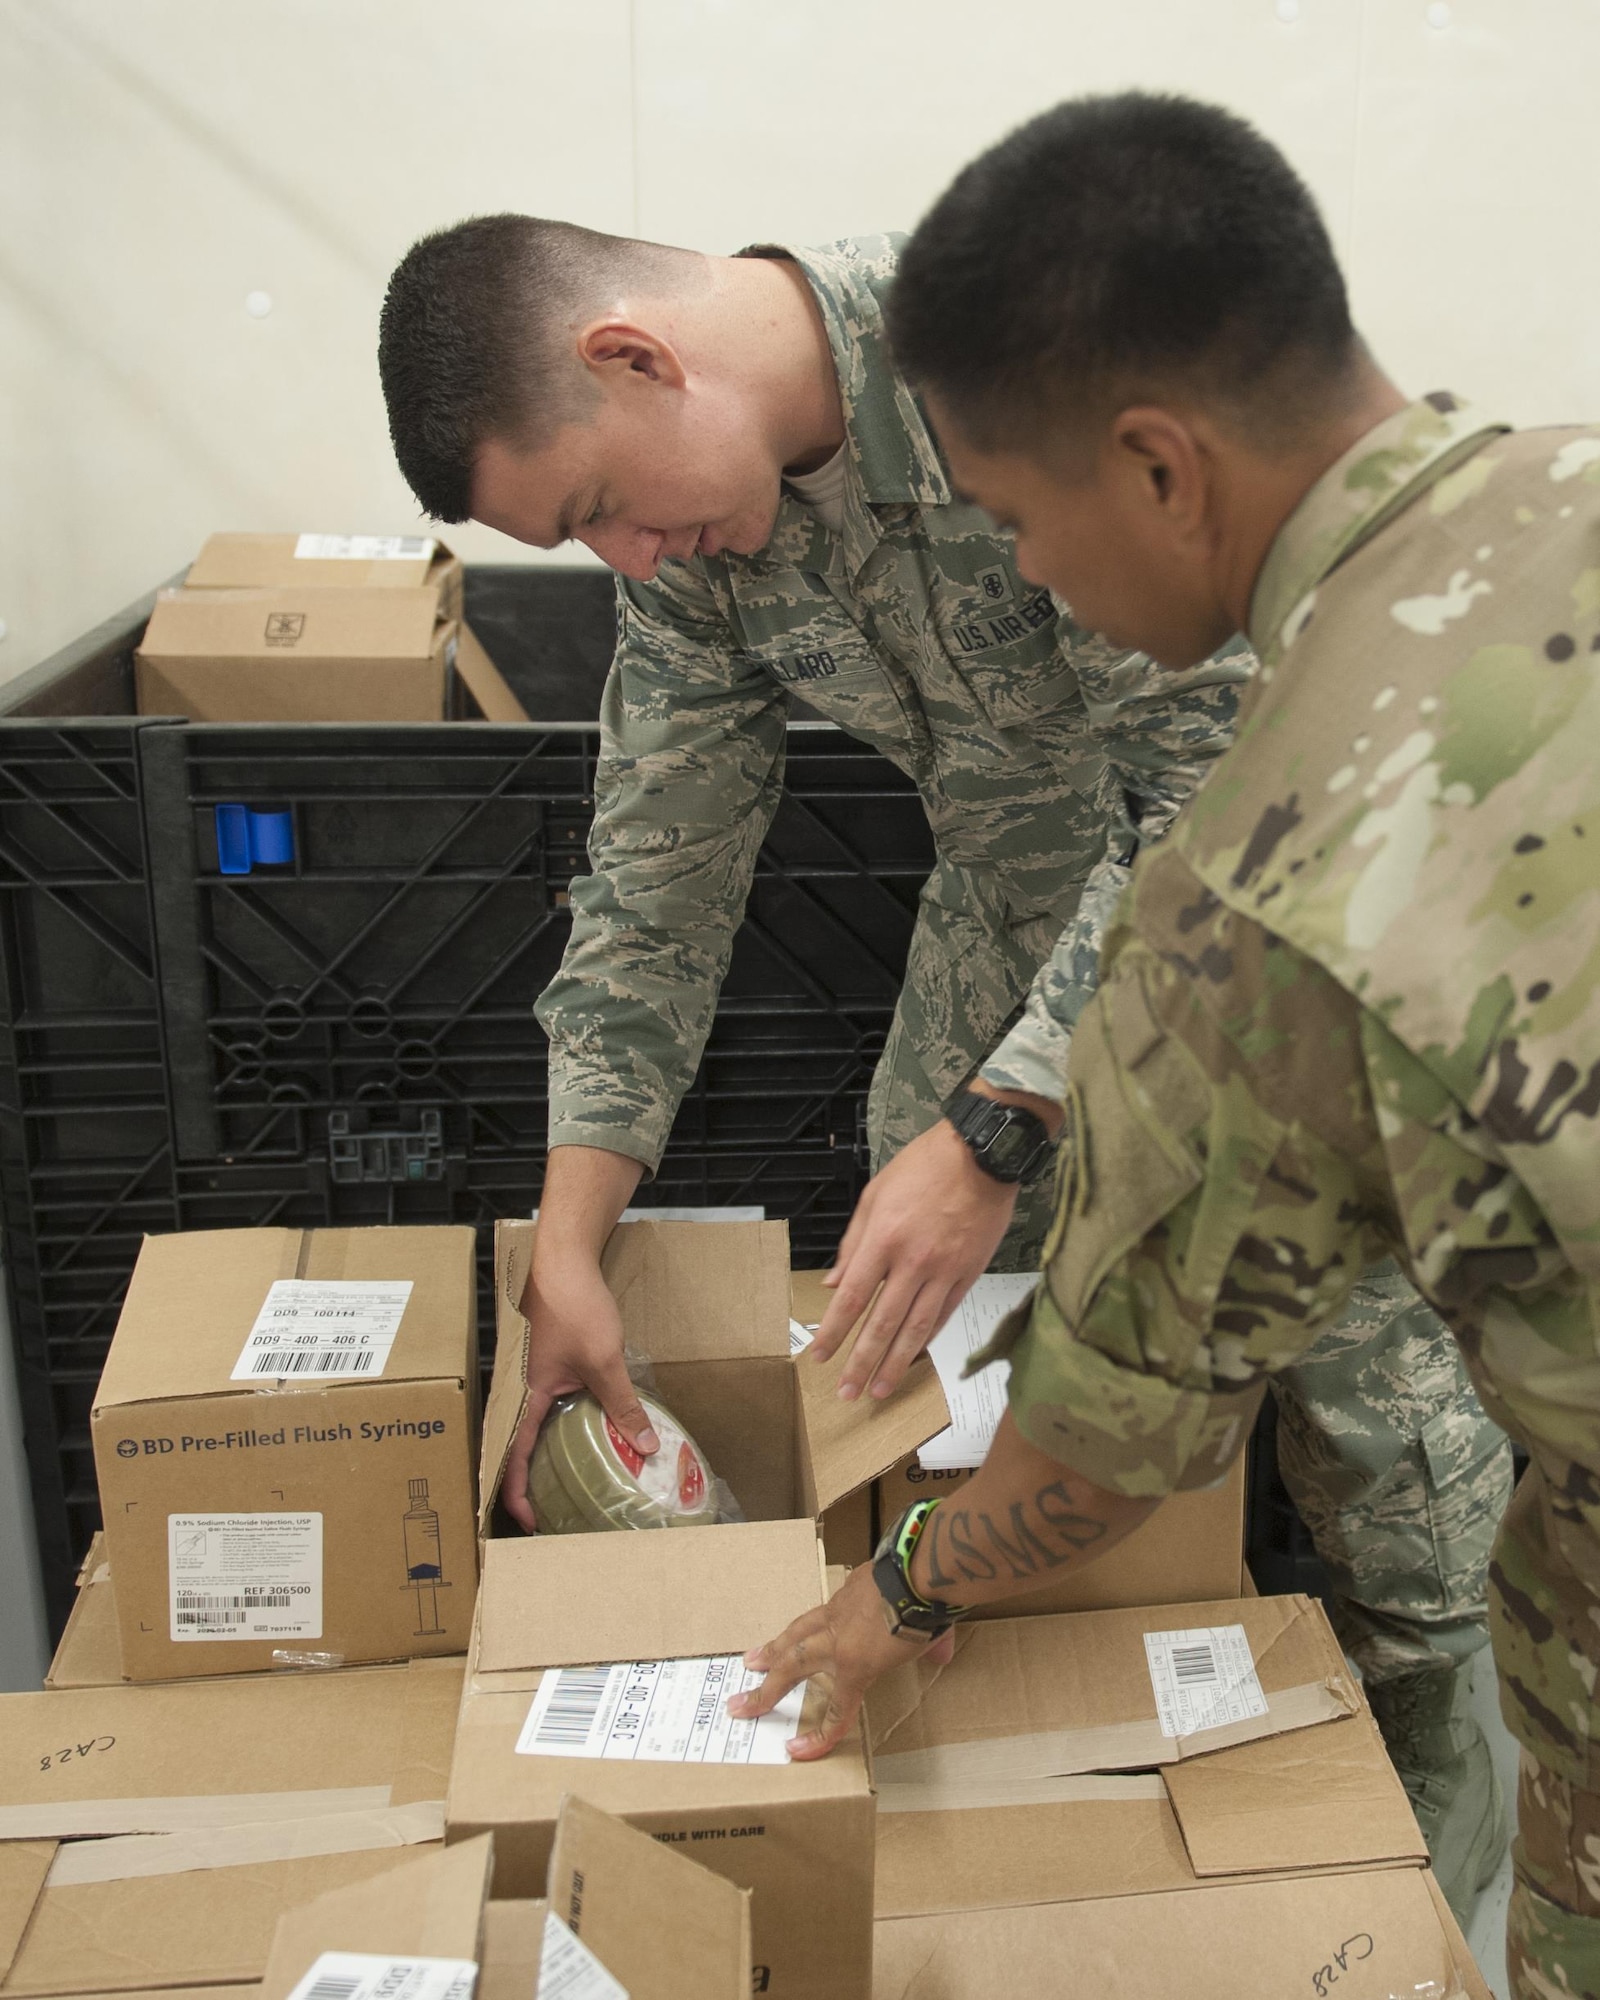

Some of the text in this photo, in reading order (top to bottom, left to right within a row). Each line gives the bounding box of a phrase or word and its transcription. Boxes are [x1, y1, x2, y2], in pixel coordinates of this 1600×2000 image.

[953, 625, 994, 652] U.S.
[988, 616, 1030, 644] AIR
[142, 1416, 446, 1456] BD Pre-Filled Flush Syringe
[177, 1589, 193, 1597] 120
[244, 1587, 266, 1596] REF
[269, 1586, 312, 1596] 306500
[39, 1734, 116, 1772] CA28
[691, 1829, 726, 1841] WITH
[730, 1826, 766, 1838] CARE
[1311, 1932, 1374, 1998] CA28
